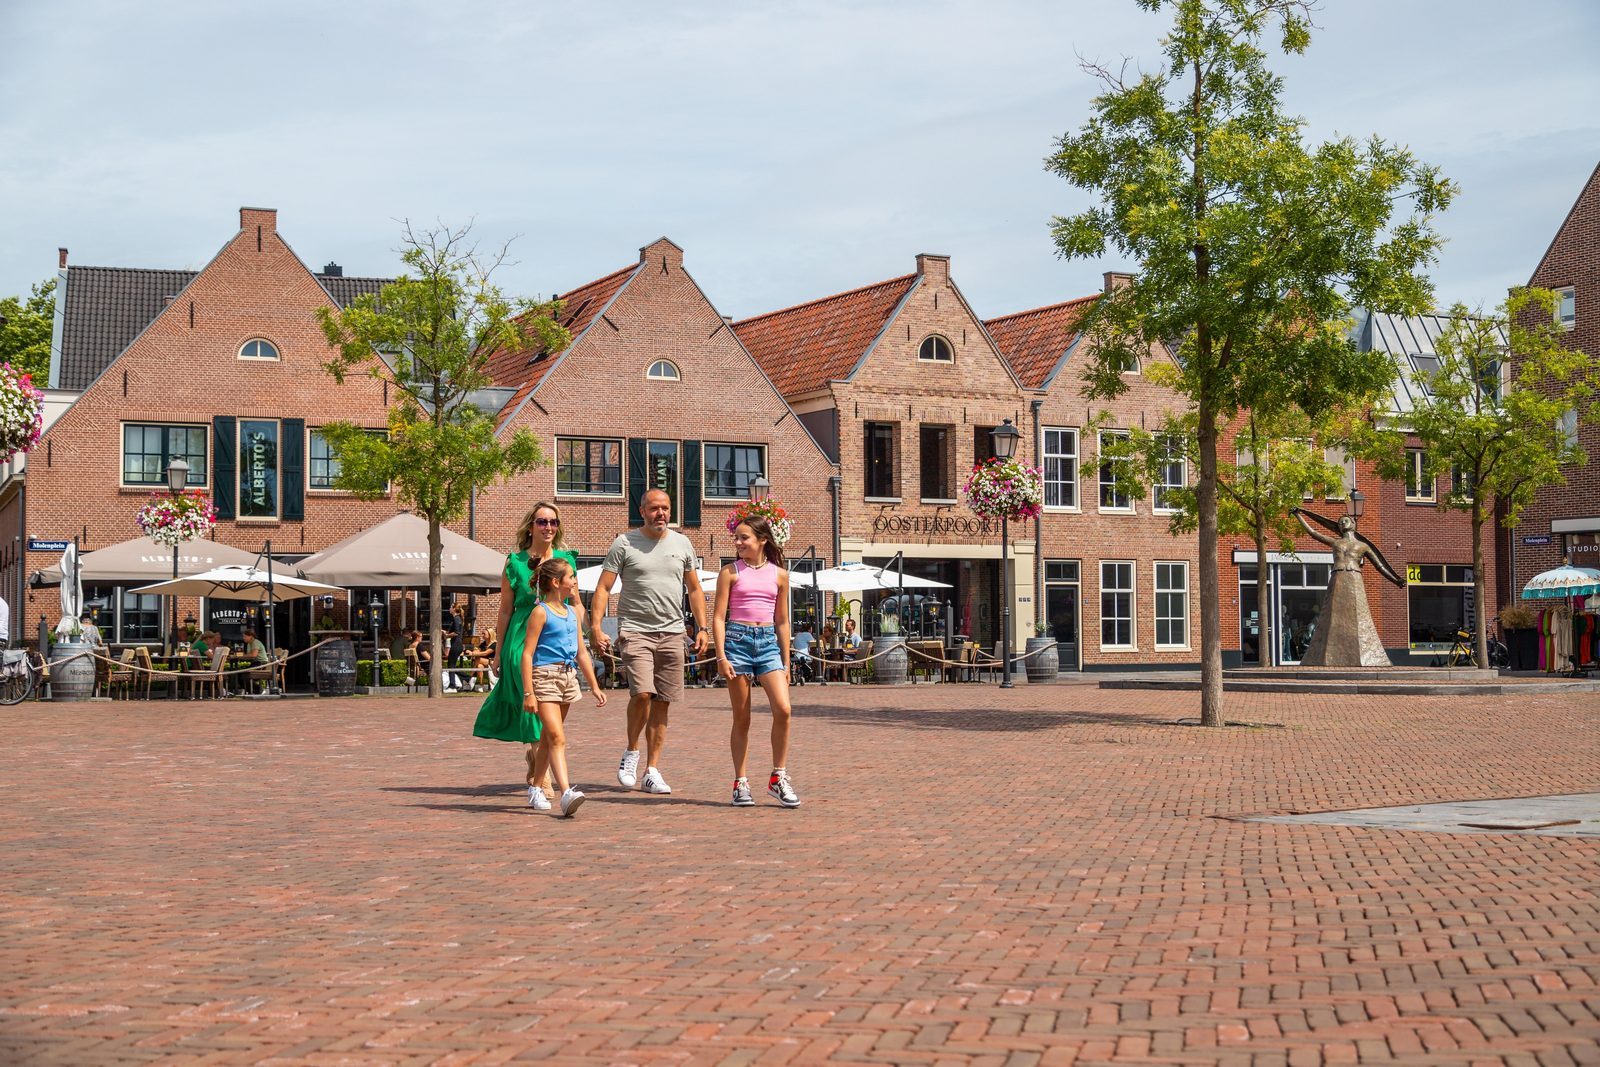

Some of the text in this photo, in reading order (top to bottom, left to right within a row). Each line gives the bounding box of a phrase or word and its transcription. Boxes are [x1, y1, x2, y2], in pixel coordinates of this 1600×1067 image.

[253, 431, 266, 506] ALBERTO'S
[657, 459, 667, 491] LIAN
[873, 515, 1000, 533] OOSTERPOORT
[32, 541, 66, 549] Molenplein
[391, 552, 457, 560] ALBER'S
[212, 610, 247, 619] ALBERTO'S
